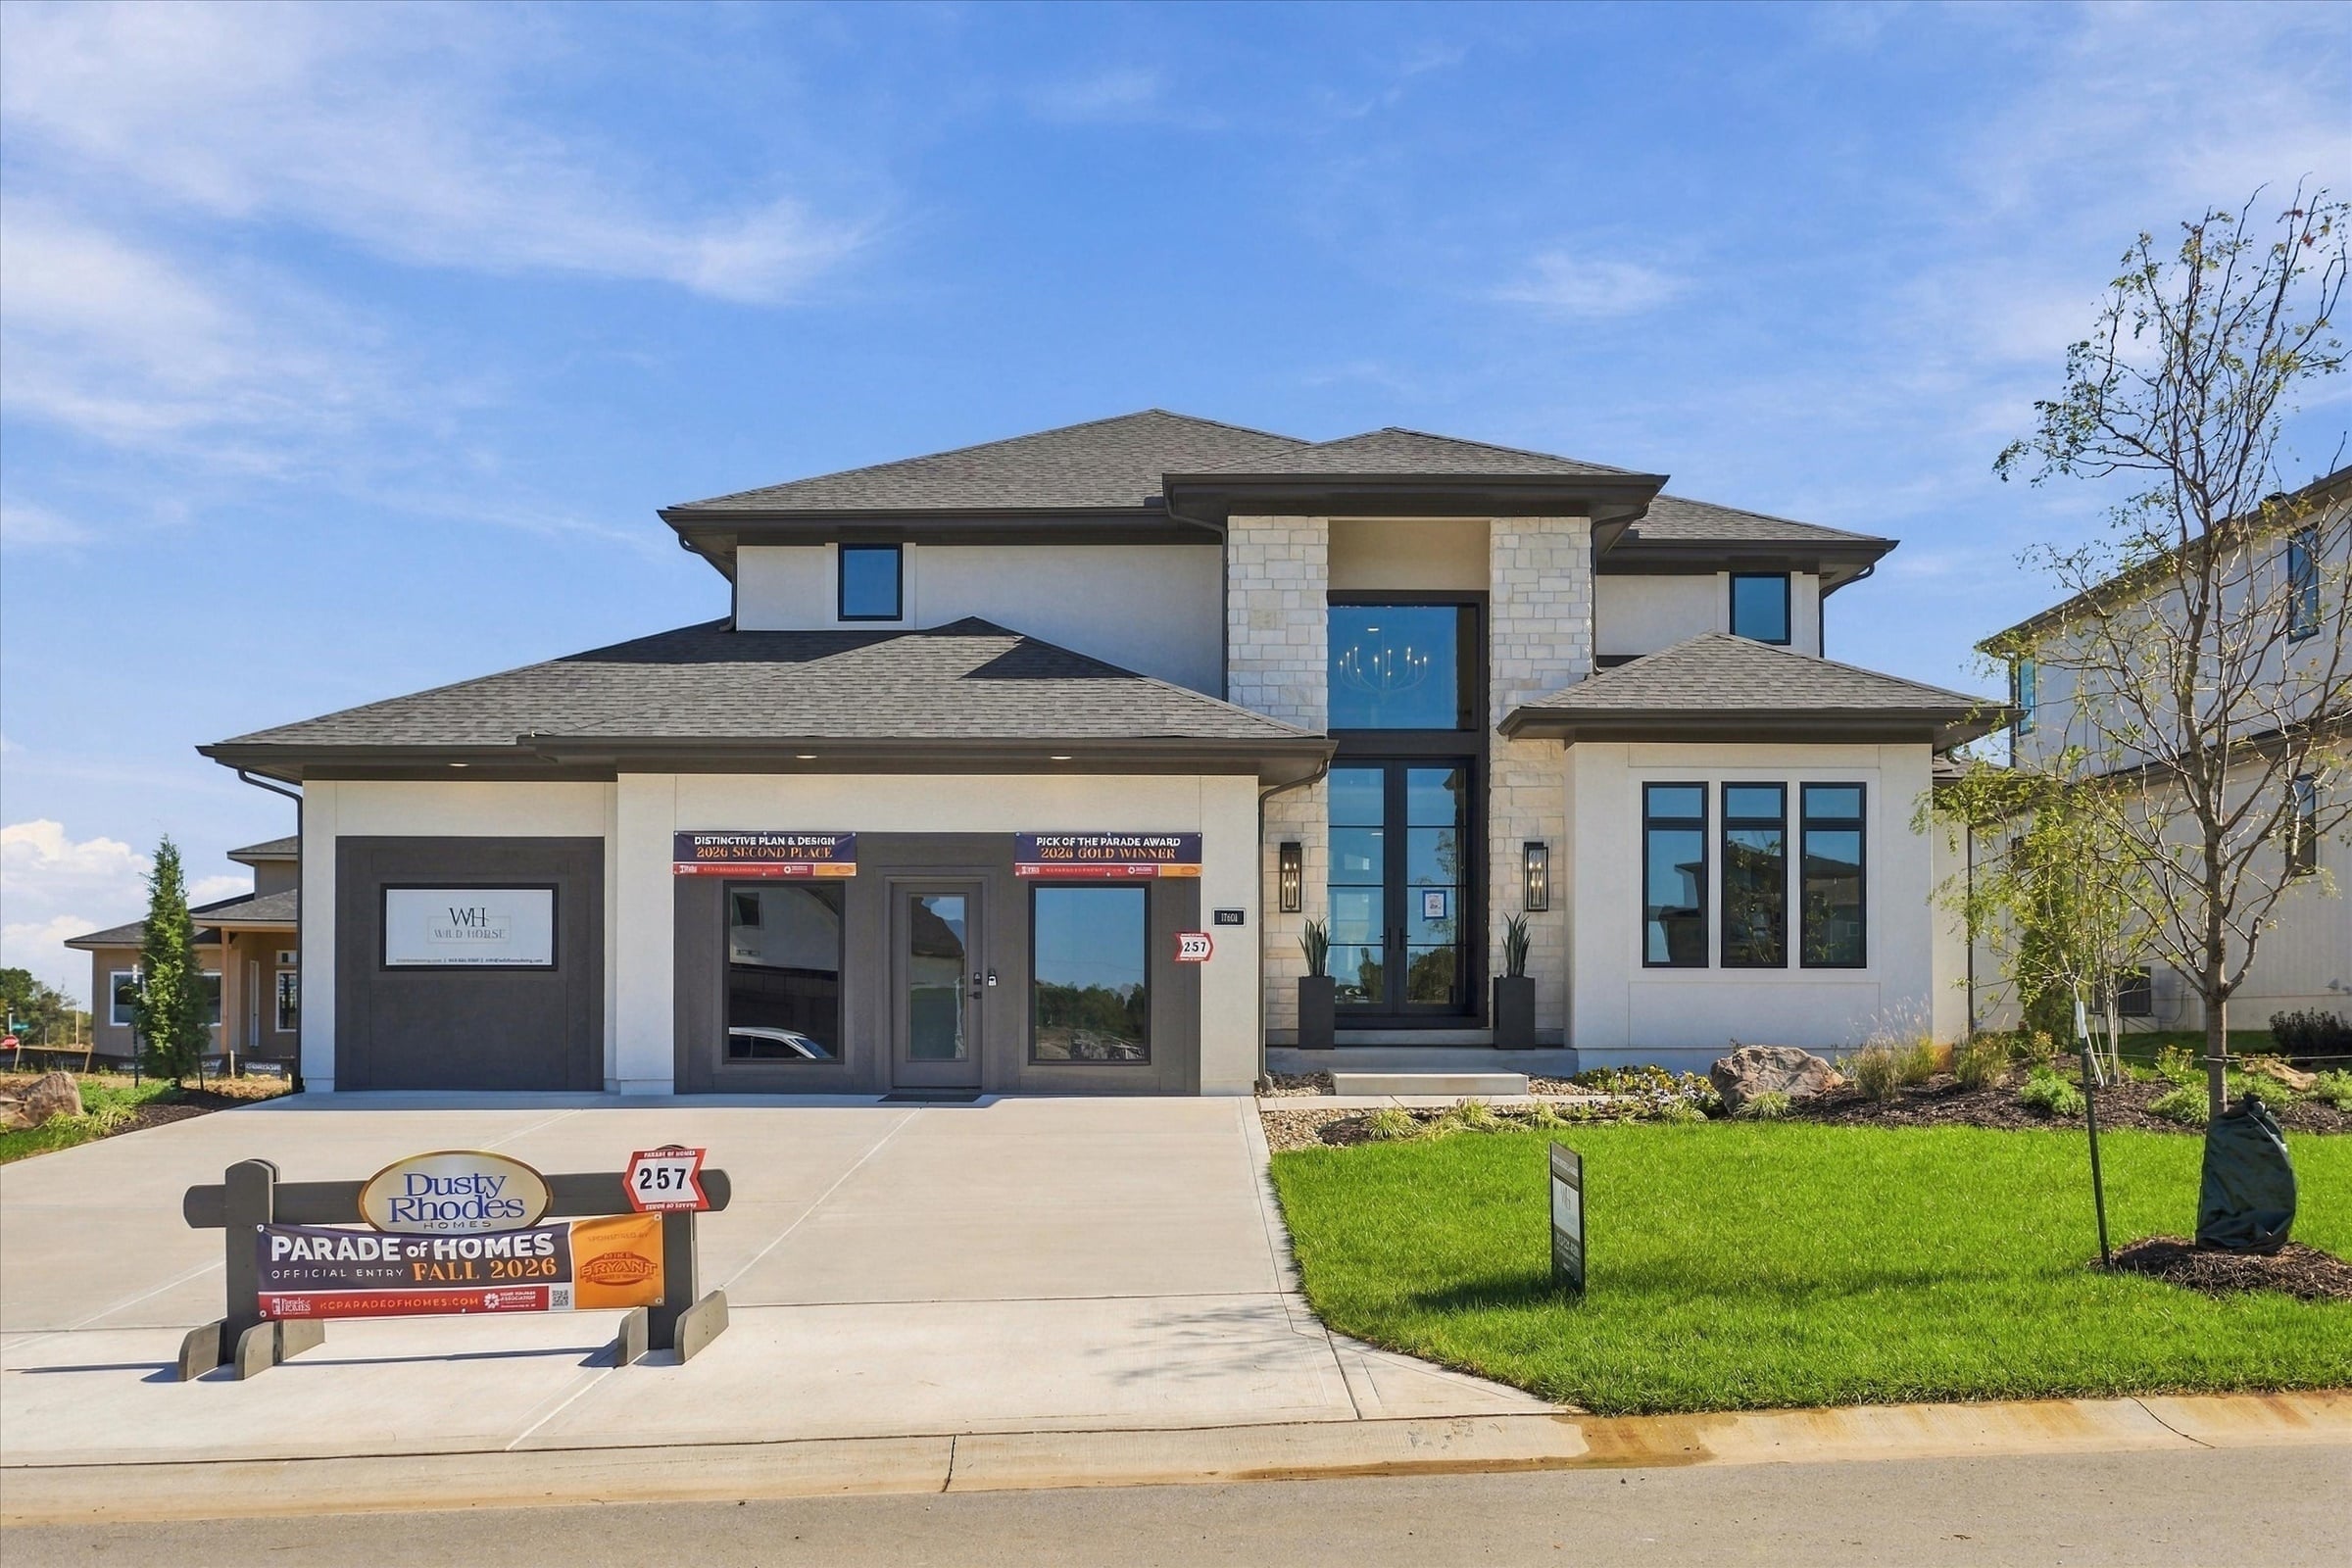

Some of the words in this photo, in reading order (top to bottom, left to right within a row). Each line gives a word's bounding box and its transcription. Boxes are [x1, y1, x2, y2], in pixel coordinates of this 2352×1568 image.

[694, 836, 757, 846] DISTINCTIVE
[759, 836, 785, 846] PLAN
[788, 836, 796, 846] &
[798, 836, 836, 846] DESIGN
[1036, 837, 1060, 846] PICK
[1061, 837, 1076, 846] OF
[1077, 837, 1098, 846] THE
[1100, 837, 1142, 847] PARADE
[1143, 838, 1181, 847] AWARD
[697, 846, 729, 858] 2026
[732, 846, 786, 858] SECOND
[790, 846, 833, 858] PLACE
[1041, 847, 1074, 859] 2026
[1078, 847, 1115, 859] GOLD
[1119, 847, 1176, 859] WINNER
[449, 906, 490, 928] WH
[433, 929, 464, 940] WILD
[466, 928, 506, 940] HORSE
[1184, 941, 1206, 953] 257
[639, 1167, 687, 1190] 257
[403, 1173, 507, 1199] Dusty
[388, 1195, 525, 1223] Rhodes
[423, 1220, 492, 1230] HOMES
[270, 1236, 402, 1262] PARADE
[406, 1241, 428, 1258] of
[433, 1233, 556, 1261] HOMES
[270, 1269, 347, 1279] OFFICIAL
[356, 1268, 404, 1277] ENTRY
[413, 1261, 480, 1282] FALL
[490, 1256, 558, 1280] 2026
[580, 1259, 658, 1280] BRYANT
[319, 1298, 478, 1310] KCPARADEOFHOMES.COM
